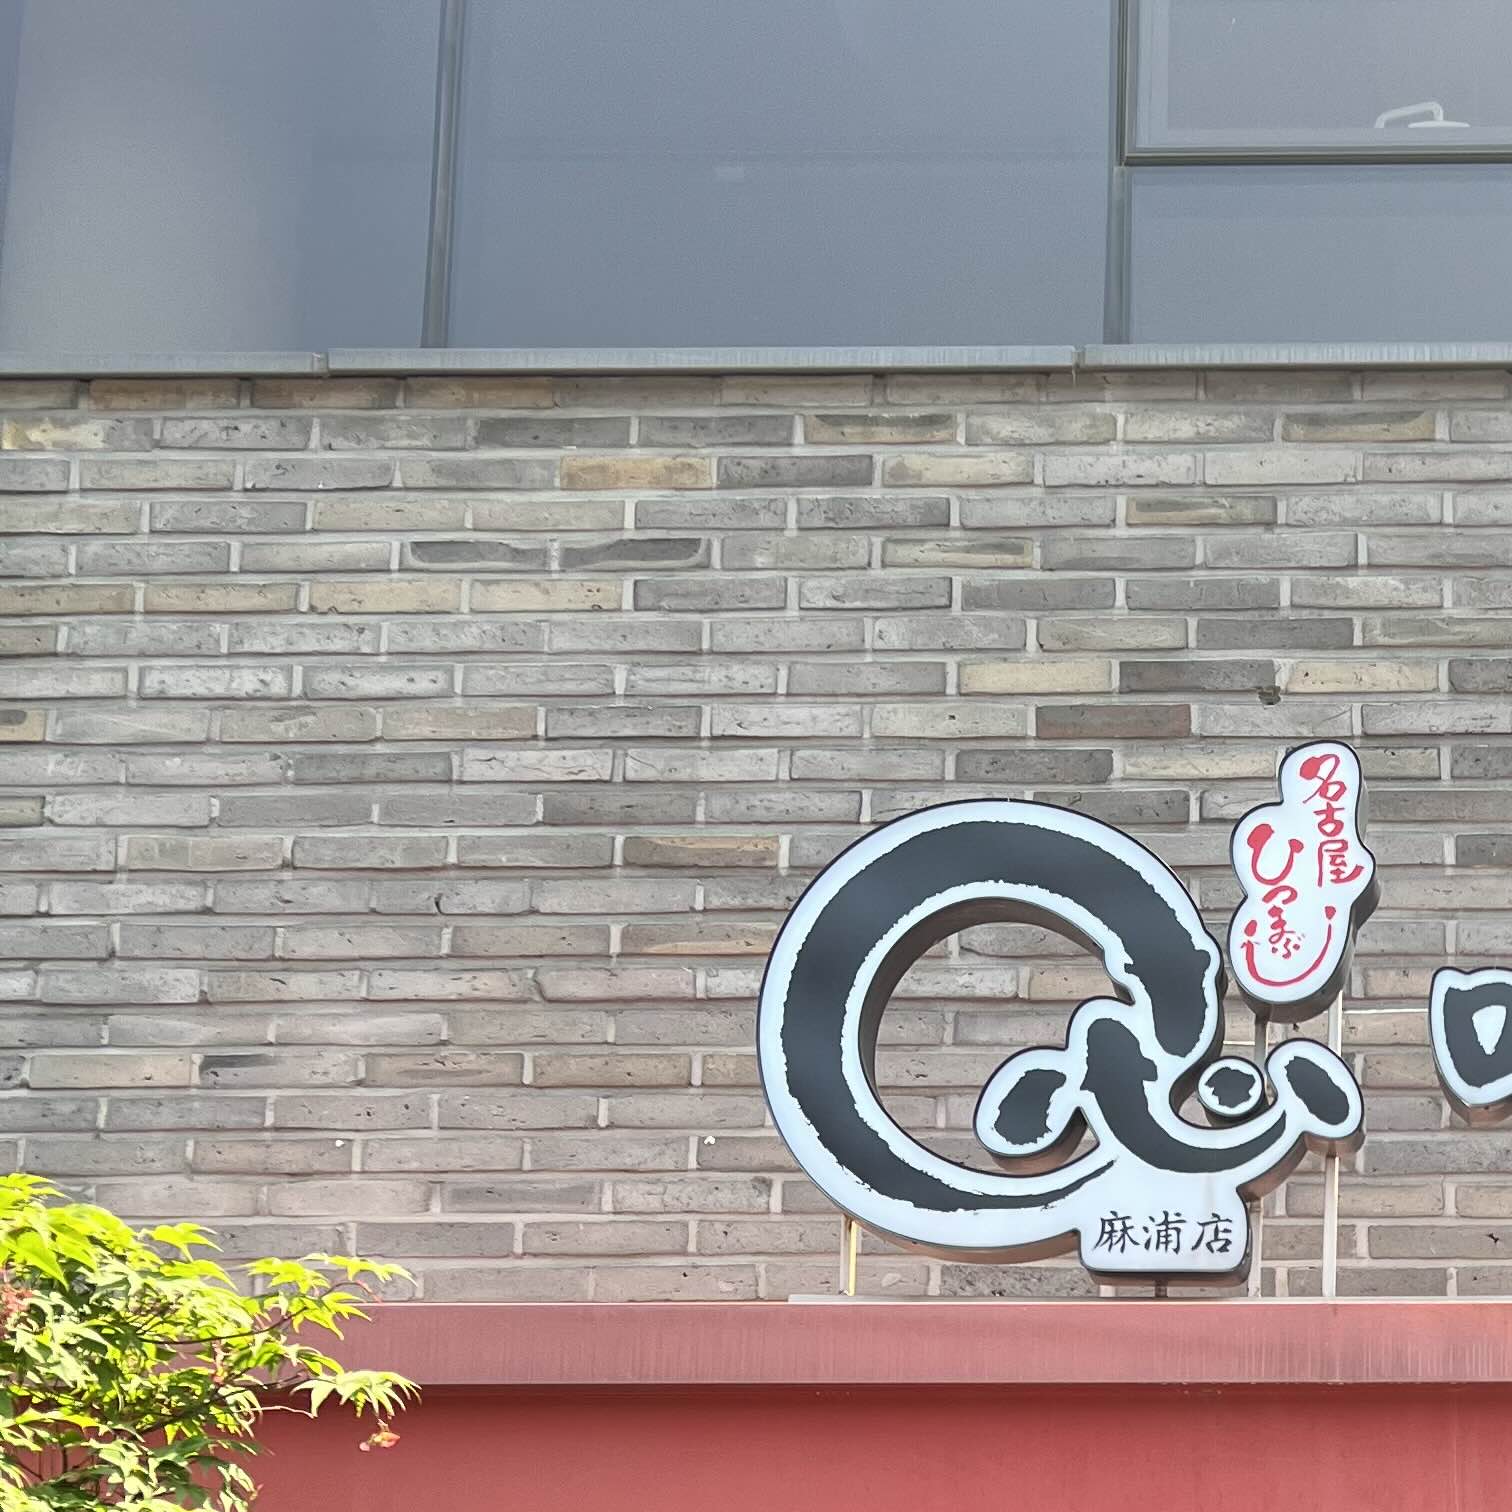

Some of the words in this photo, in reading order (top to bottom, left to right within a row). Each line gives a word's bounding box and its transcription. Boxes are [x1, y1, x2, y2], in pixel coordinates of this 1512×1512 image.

[1299, 753, 1365, 888] 名古屋
[1092, 1209, 1235, 1254] 麻浦店
